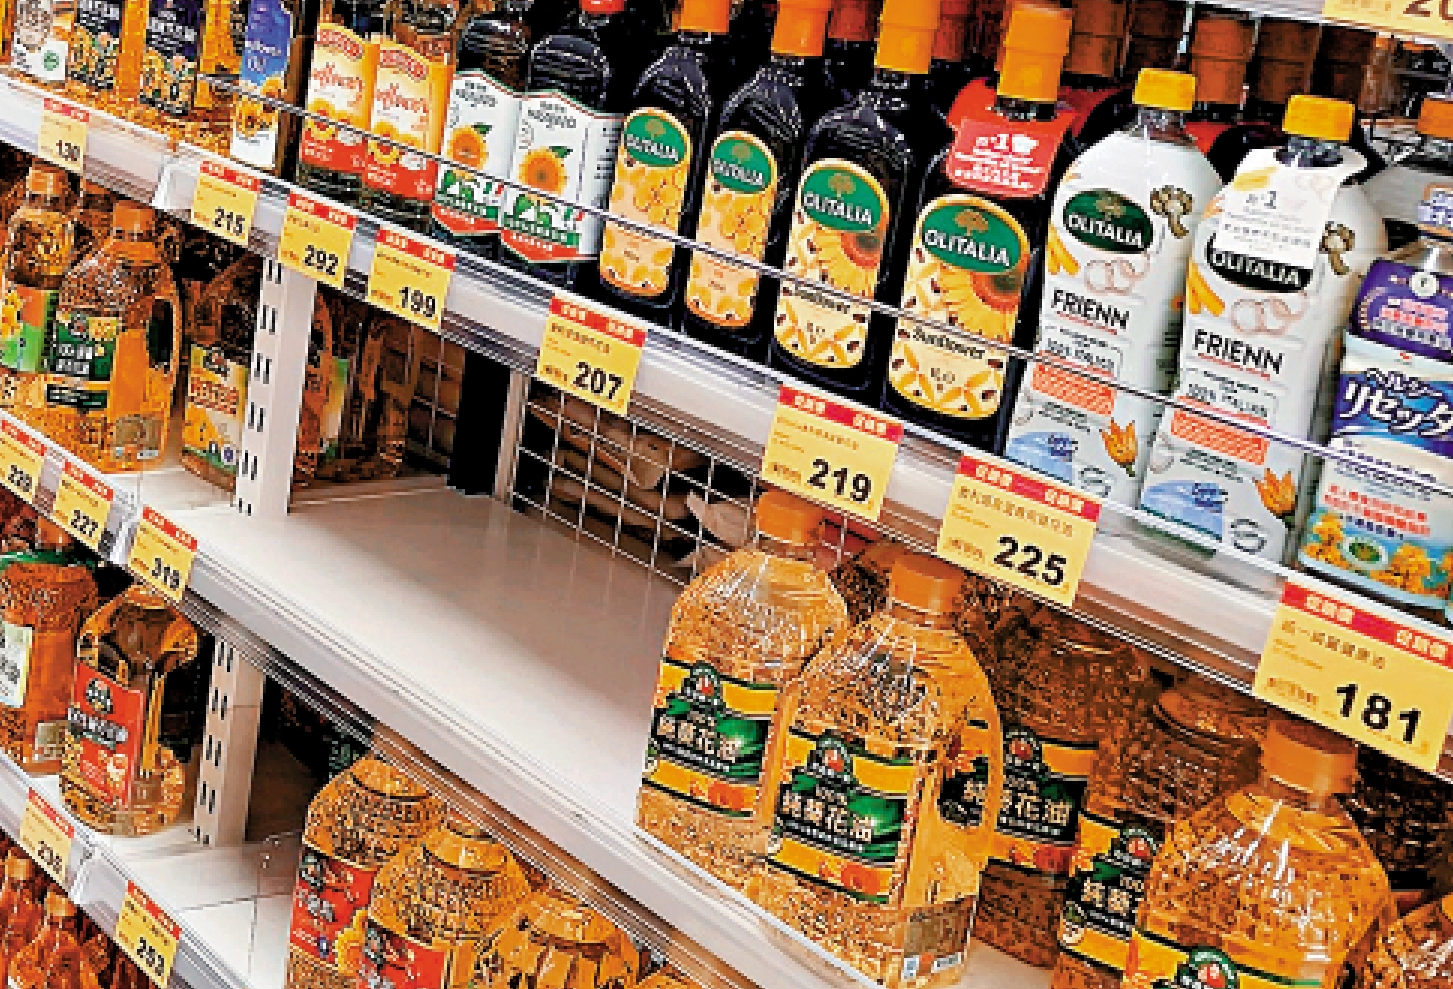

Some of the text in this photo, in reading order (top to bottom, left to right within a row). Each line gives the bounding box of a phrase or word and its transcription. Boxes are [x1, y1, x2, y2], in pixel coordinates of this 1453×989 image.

[212, 208, 247, 237] 215
[802, 191, 873, 227] OLITALIA
[923, 227, 1011, 268] OLITALIA
[1067, 212, 1145, 250] OLITALIA
[303, 245, 340, 277] 292
[1209, 250, 1303, 289] OLITALIA
[398, 285, 437, 319] 199
[1050, 288, 1131, 331] FRIENN
[1192, 328, 1286, 376] FRIENN
[574, 361, 624, 402] 207
[808, 457, 873, 504] 219
[151, 558, 183, 591] 319
[993, 535, 1067, 589] 225
[1336, 683, 1423, 745] 181
